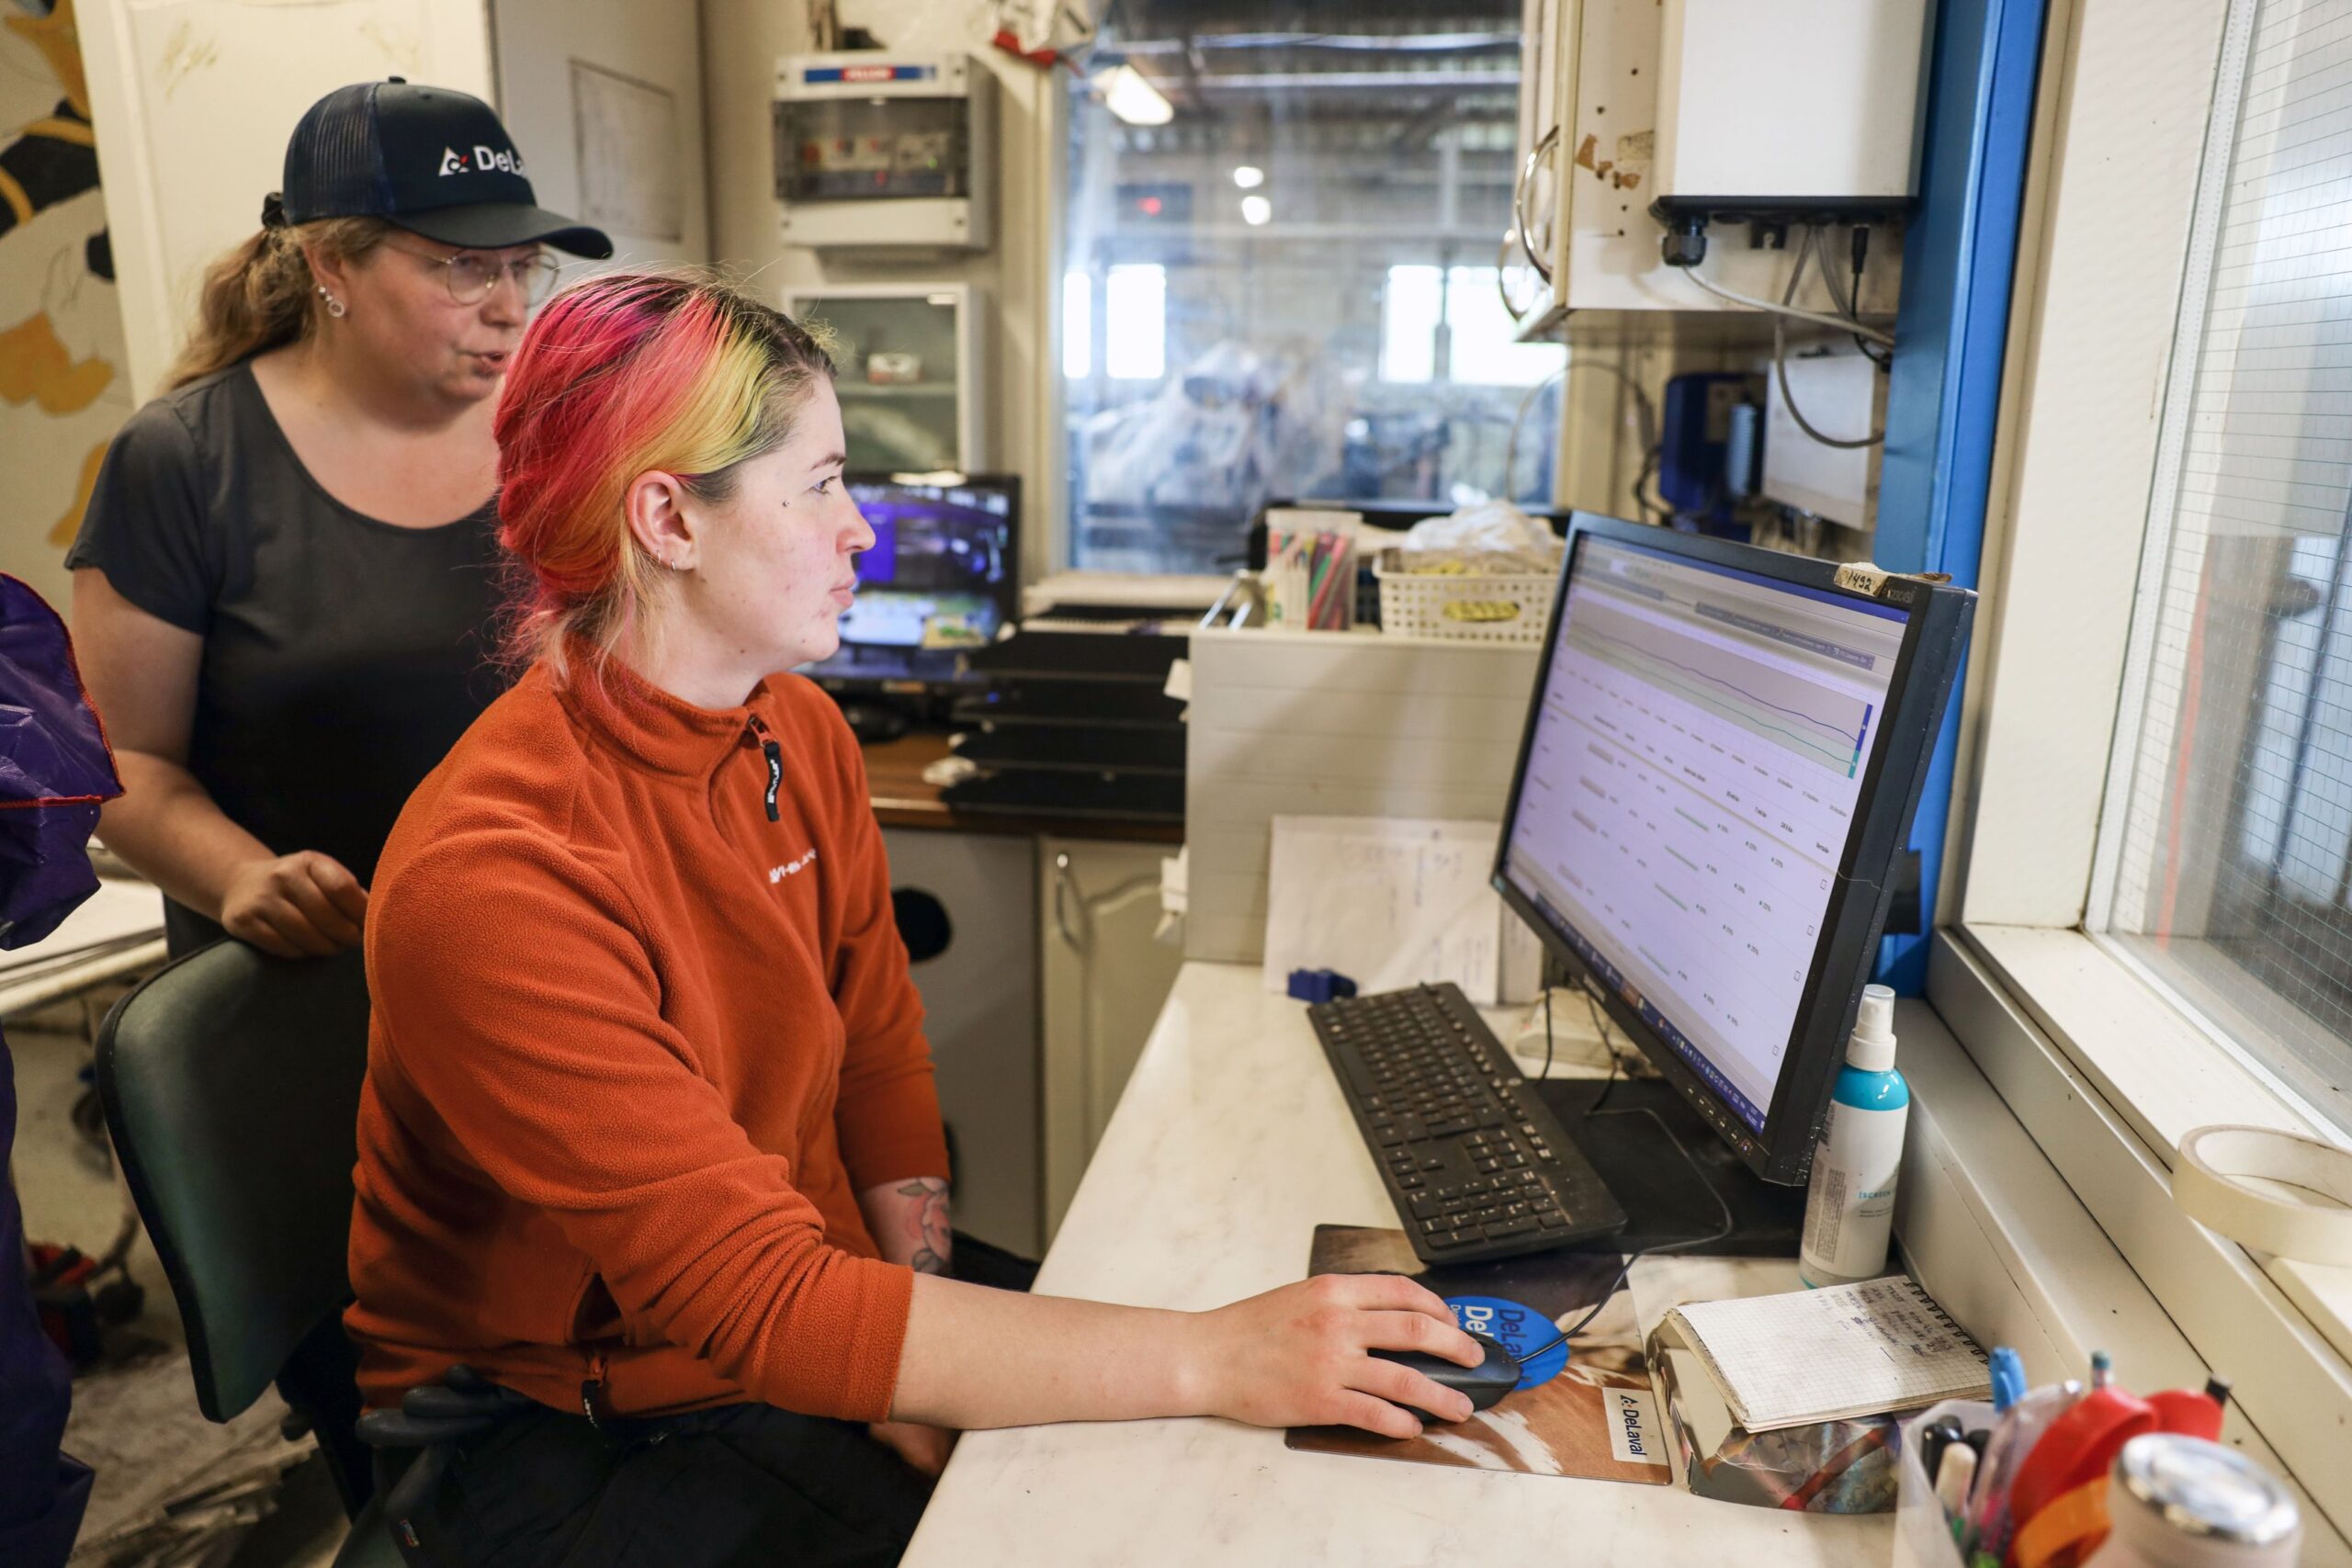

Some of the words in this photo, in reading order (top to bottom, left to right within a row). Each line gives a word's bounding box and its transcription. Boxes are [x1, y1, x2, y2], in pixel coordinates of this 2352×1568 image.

[1846, 570, 1871, 591] 1492
[1498, 1308, 1527, 1359] DeLa
[1623, 1409, 1647, 1456] DeLaval
